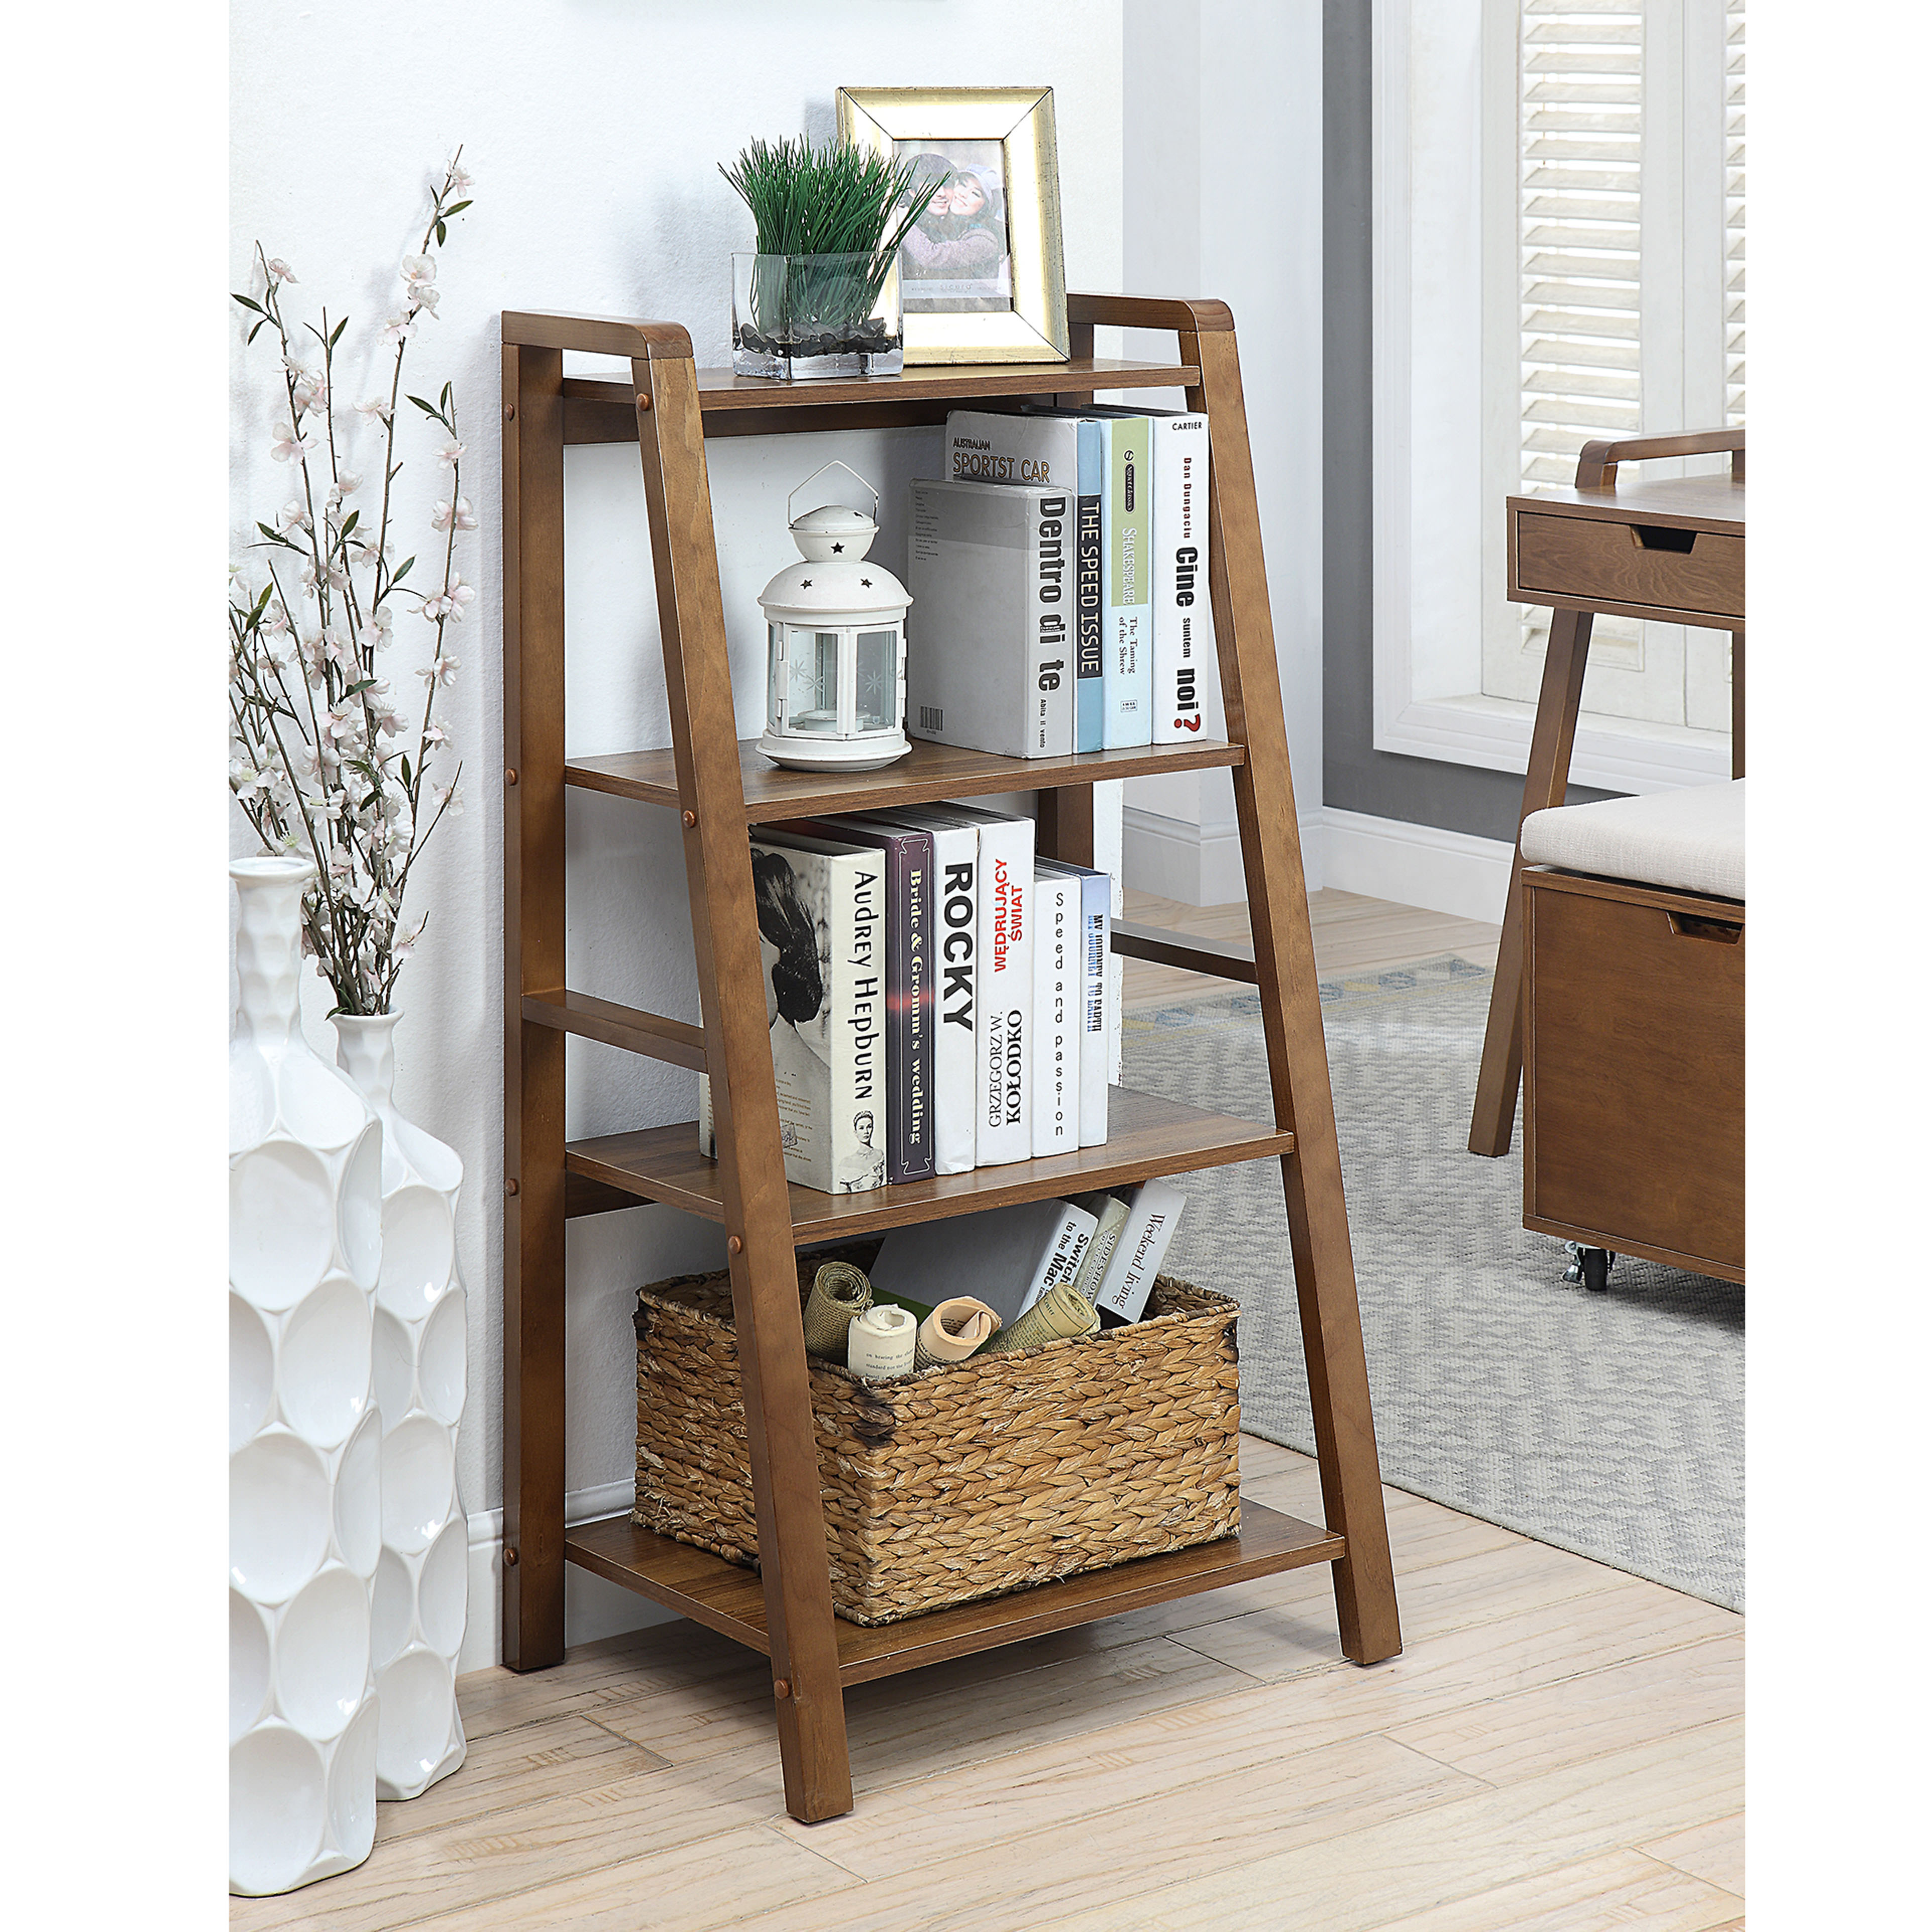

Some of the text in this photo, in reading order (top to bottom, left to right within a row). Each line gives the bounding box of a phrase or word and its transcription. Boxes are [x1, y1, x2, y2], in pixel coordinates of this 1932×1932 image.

[953, 437, 990, 451] AUSTRALIAN
[1172, 422, 1202, 431] CARTIER
[953, 452, 1049, 483] SPORTST CAR
[1183, 458, 1192, 538] Dan Dungaciu
[1038, 497, 1066, 691] Dentro di te
[1081, 502, 1099, 673] THE SPEED ISSUE
[1122, 527, 1137, 605] SHAKESPEARE
[1176, 547, 1198, 607] Cine
[1119, 617, 1127, 675] of the Shrew
[1127, 616, 1138, 674] The Taming
[1183, 617, 1192, 658] suntem
[910, 868, 922, 928] Bride
[995, 858, 1010, 973] WĘDRUJĄCY
[1008, 885, 1022, 941] ŚWIAT
[1055, 892, 1063, 969] Speed
[910, 932, 923, 952] &
[943, 863, 973, 1031] ROCKY
[1087, 914, 1103, 1032] MY JOURNEY TO EARTH
[909, 1058, 924, 1144] wedding
[989, 1011, 1003, 1127] GRZEGORZ W.
[1006, 1010, 1022, 1126] KOŁODKO
[1043, 1221, 1077, 1286] to the Mac
[1060, 1233, 1089, 1283] Switch
[1086, 1233, 1116, 1302] SIDESHOW
[1112, 1214, 1166, 1309] Weekend living
